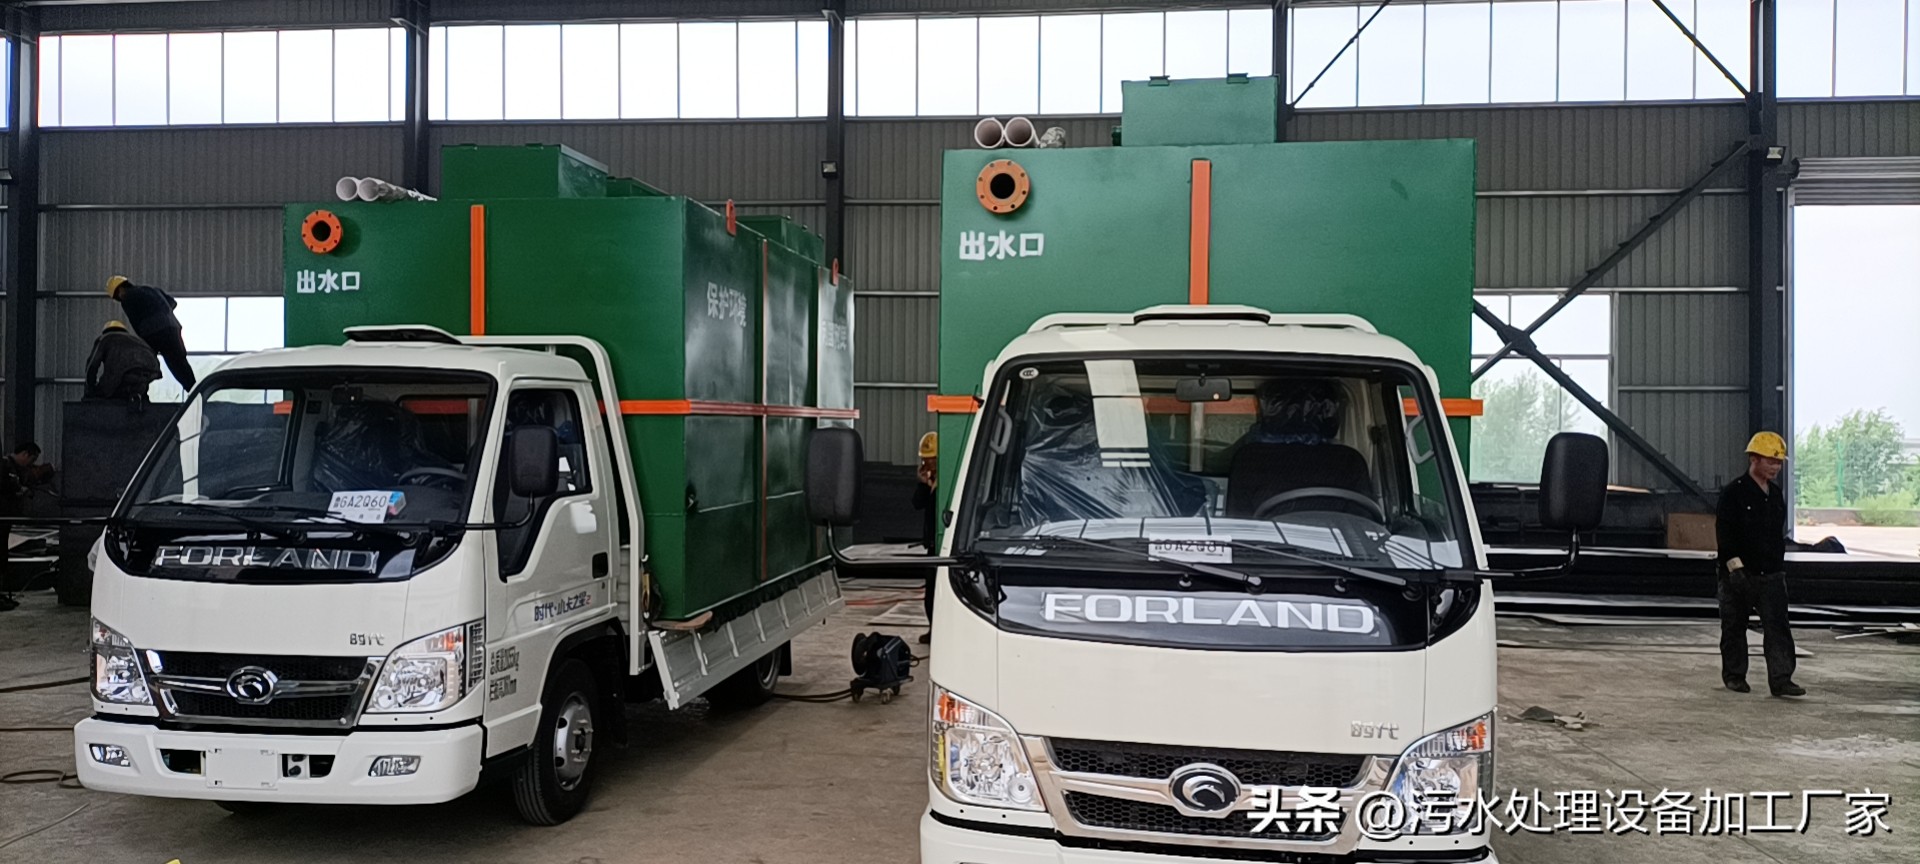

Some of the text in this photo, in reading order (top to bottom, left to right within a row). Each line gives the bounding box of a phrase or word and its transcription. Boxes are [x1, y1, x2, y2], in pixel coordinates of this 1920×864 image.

[959, 230, 1044, 260] 出水口
[297, 269, 360, 293] 出水口
[707, 282, 746, 328] 保护环境
[154, 545, 379, 574] FORLAND
[1044, 593, 1377, 634] FORLAND
